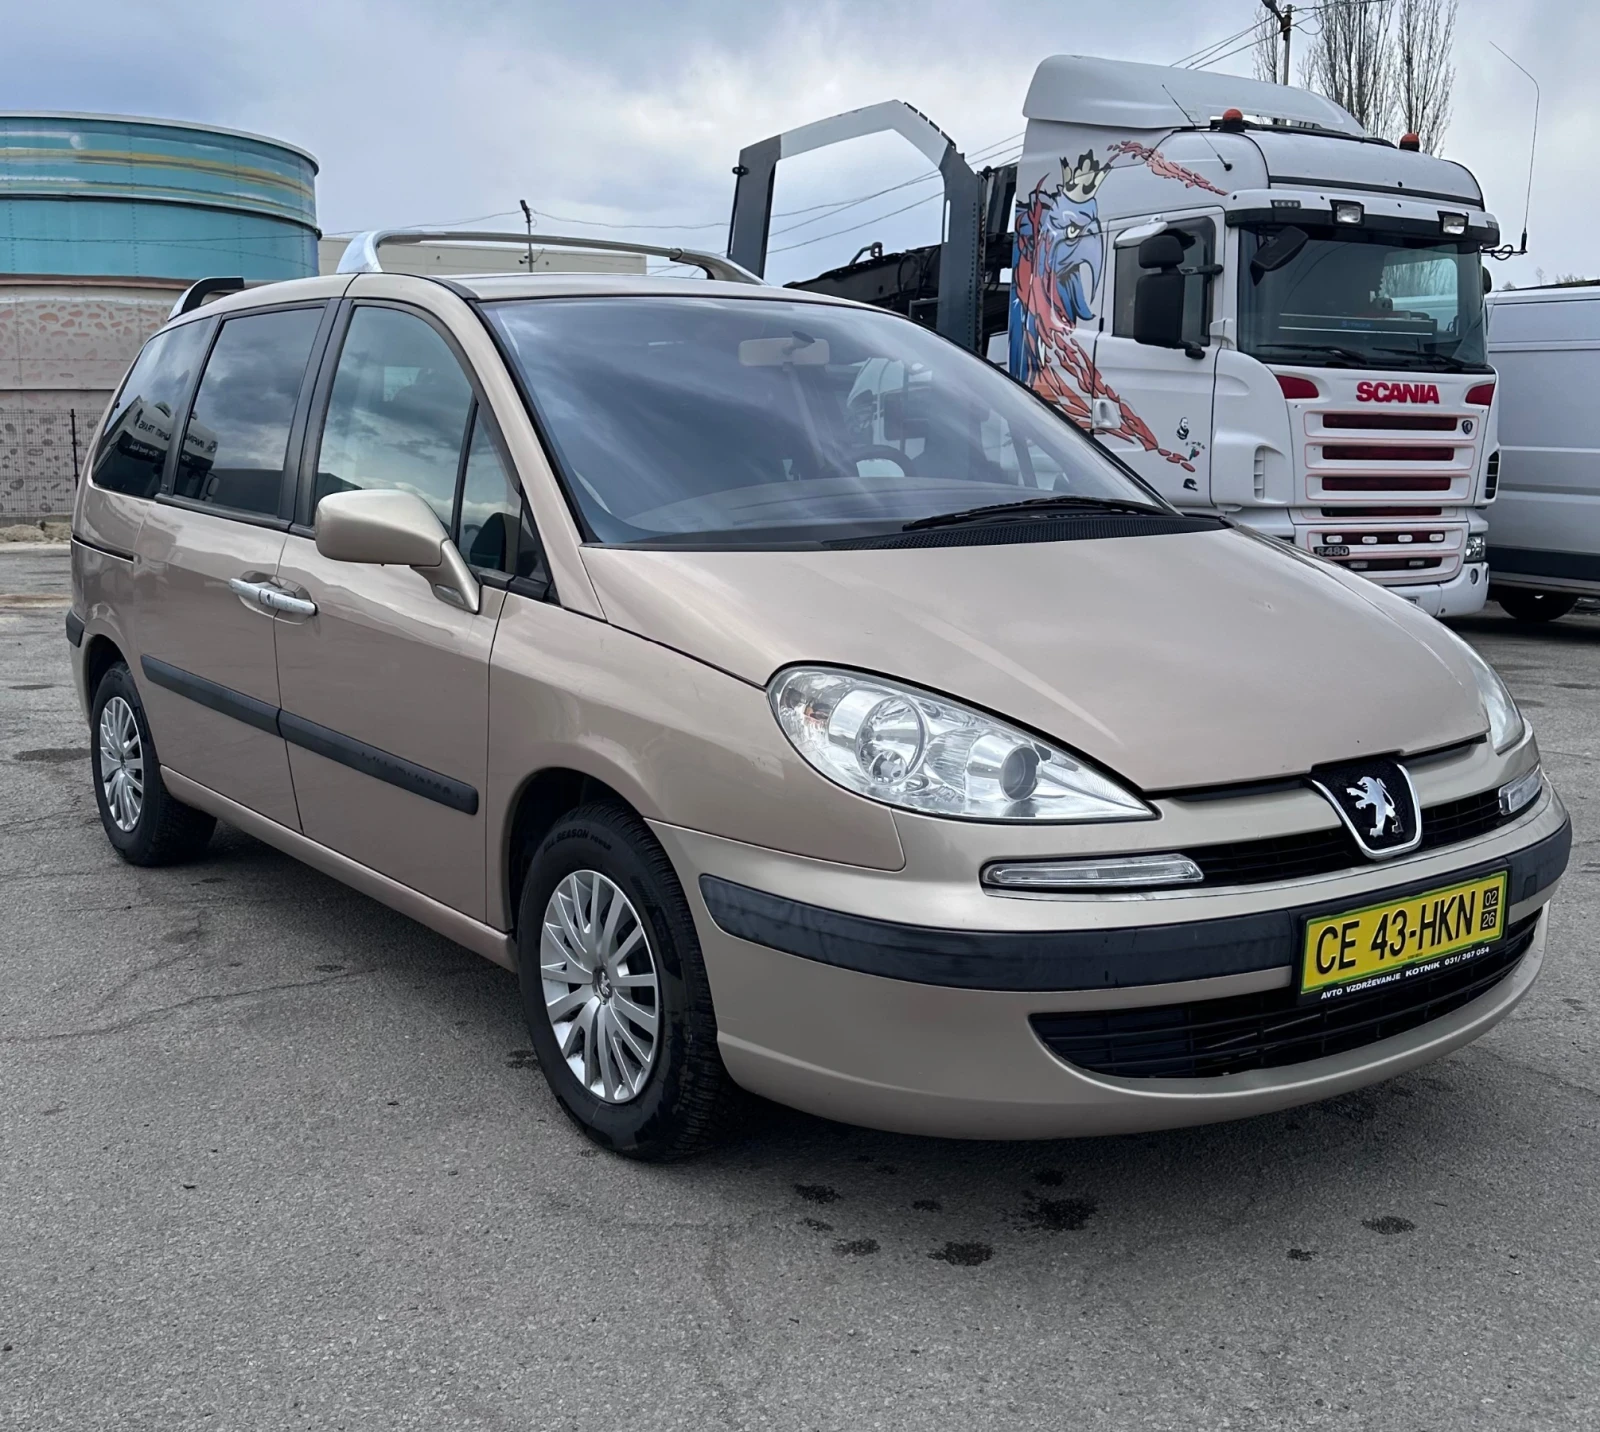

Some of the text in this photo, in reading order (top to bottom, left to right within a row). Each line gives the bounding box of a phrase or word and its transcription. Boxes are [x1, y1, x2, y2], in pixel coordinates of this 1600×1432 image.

[1356, 381, 1440, 404] SCANIA
[1317, 546, 1349, 556] R480
[556, 829, 589, 843] SEASON
[1484, 890, 1498, 906] 02
[1481, 912, 1496, 928] 26
[1316, 890, 1476, 975] CE 43-HKN
[1320, 987, 1343, 1000] AVTO
[1346, 972, 1402, 993] VZDRŽEVANJE
[1405, 961, 1440, 977] KOTNIK
[1476, 946, 1490, 956] 054
